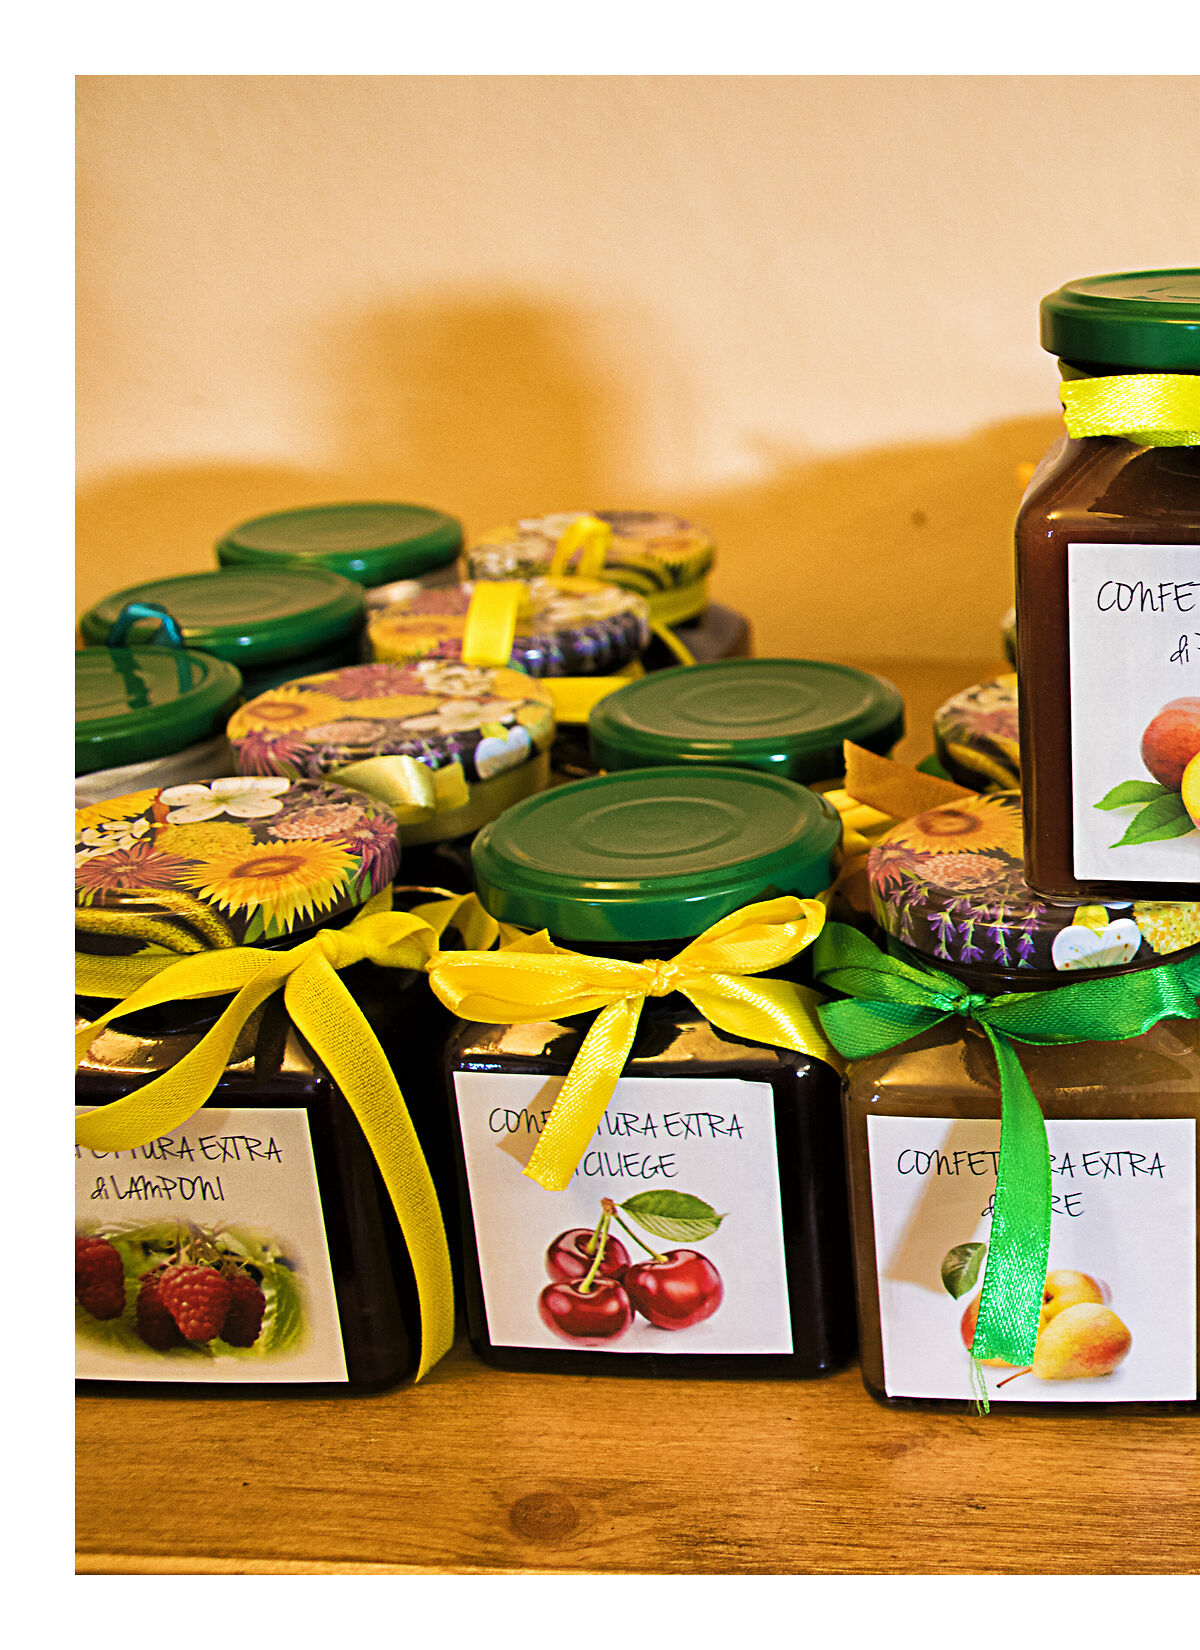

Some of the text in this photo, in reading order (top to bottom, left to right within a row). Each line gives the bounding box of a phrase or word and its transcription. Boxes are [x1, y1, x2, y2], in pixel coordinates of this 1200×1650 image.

[1169, 634, 1190, 665] di
[489, 1107, 744, 1140] CONURA EXTRA
[198, 1134, 283, 1164] EXTRA
[897, 1149, 1166, 1179] CONFETRA EXTRA
[583, 1151, 679, 1179] CILIEGE
[91, 1174, 225, 1202] di LAMPONI
